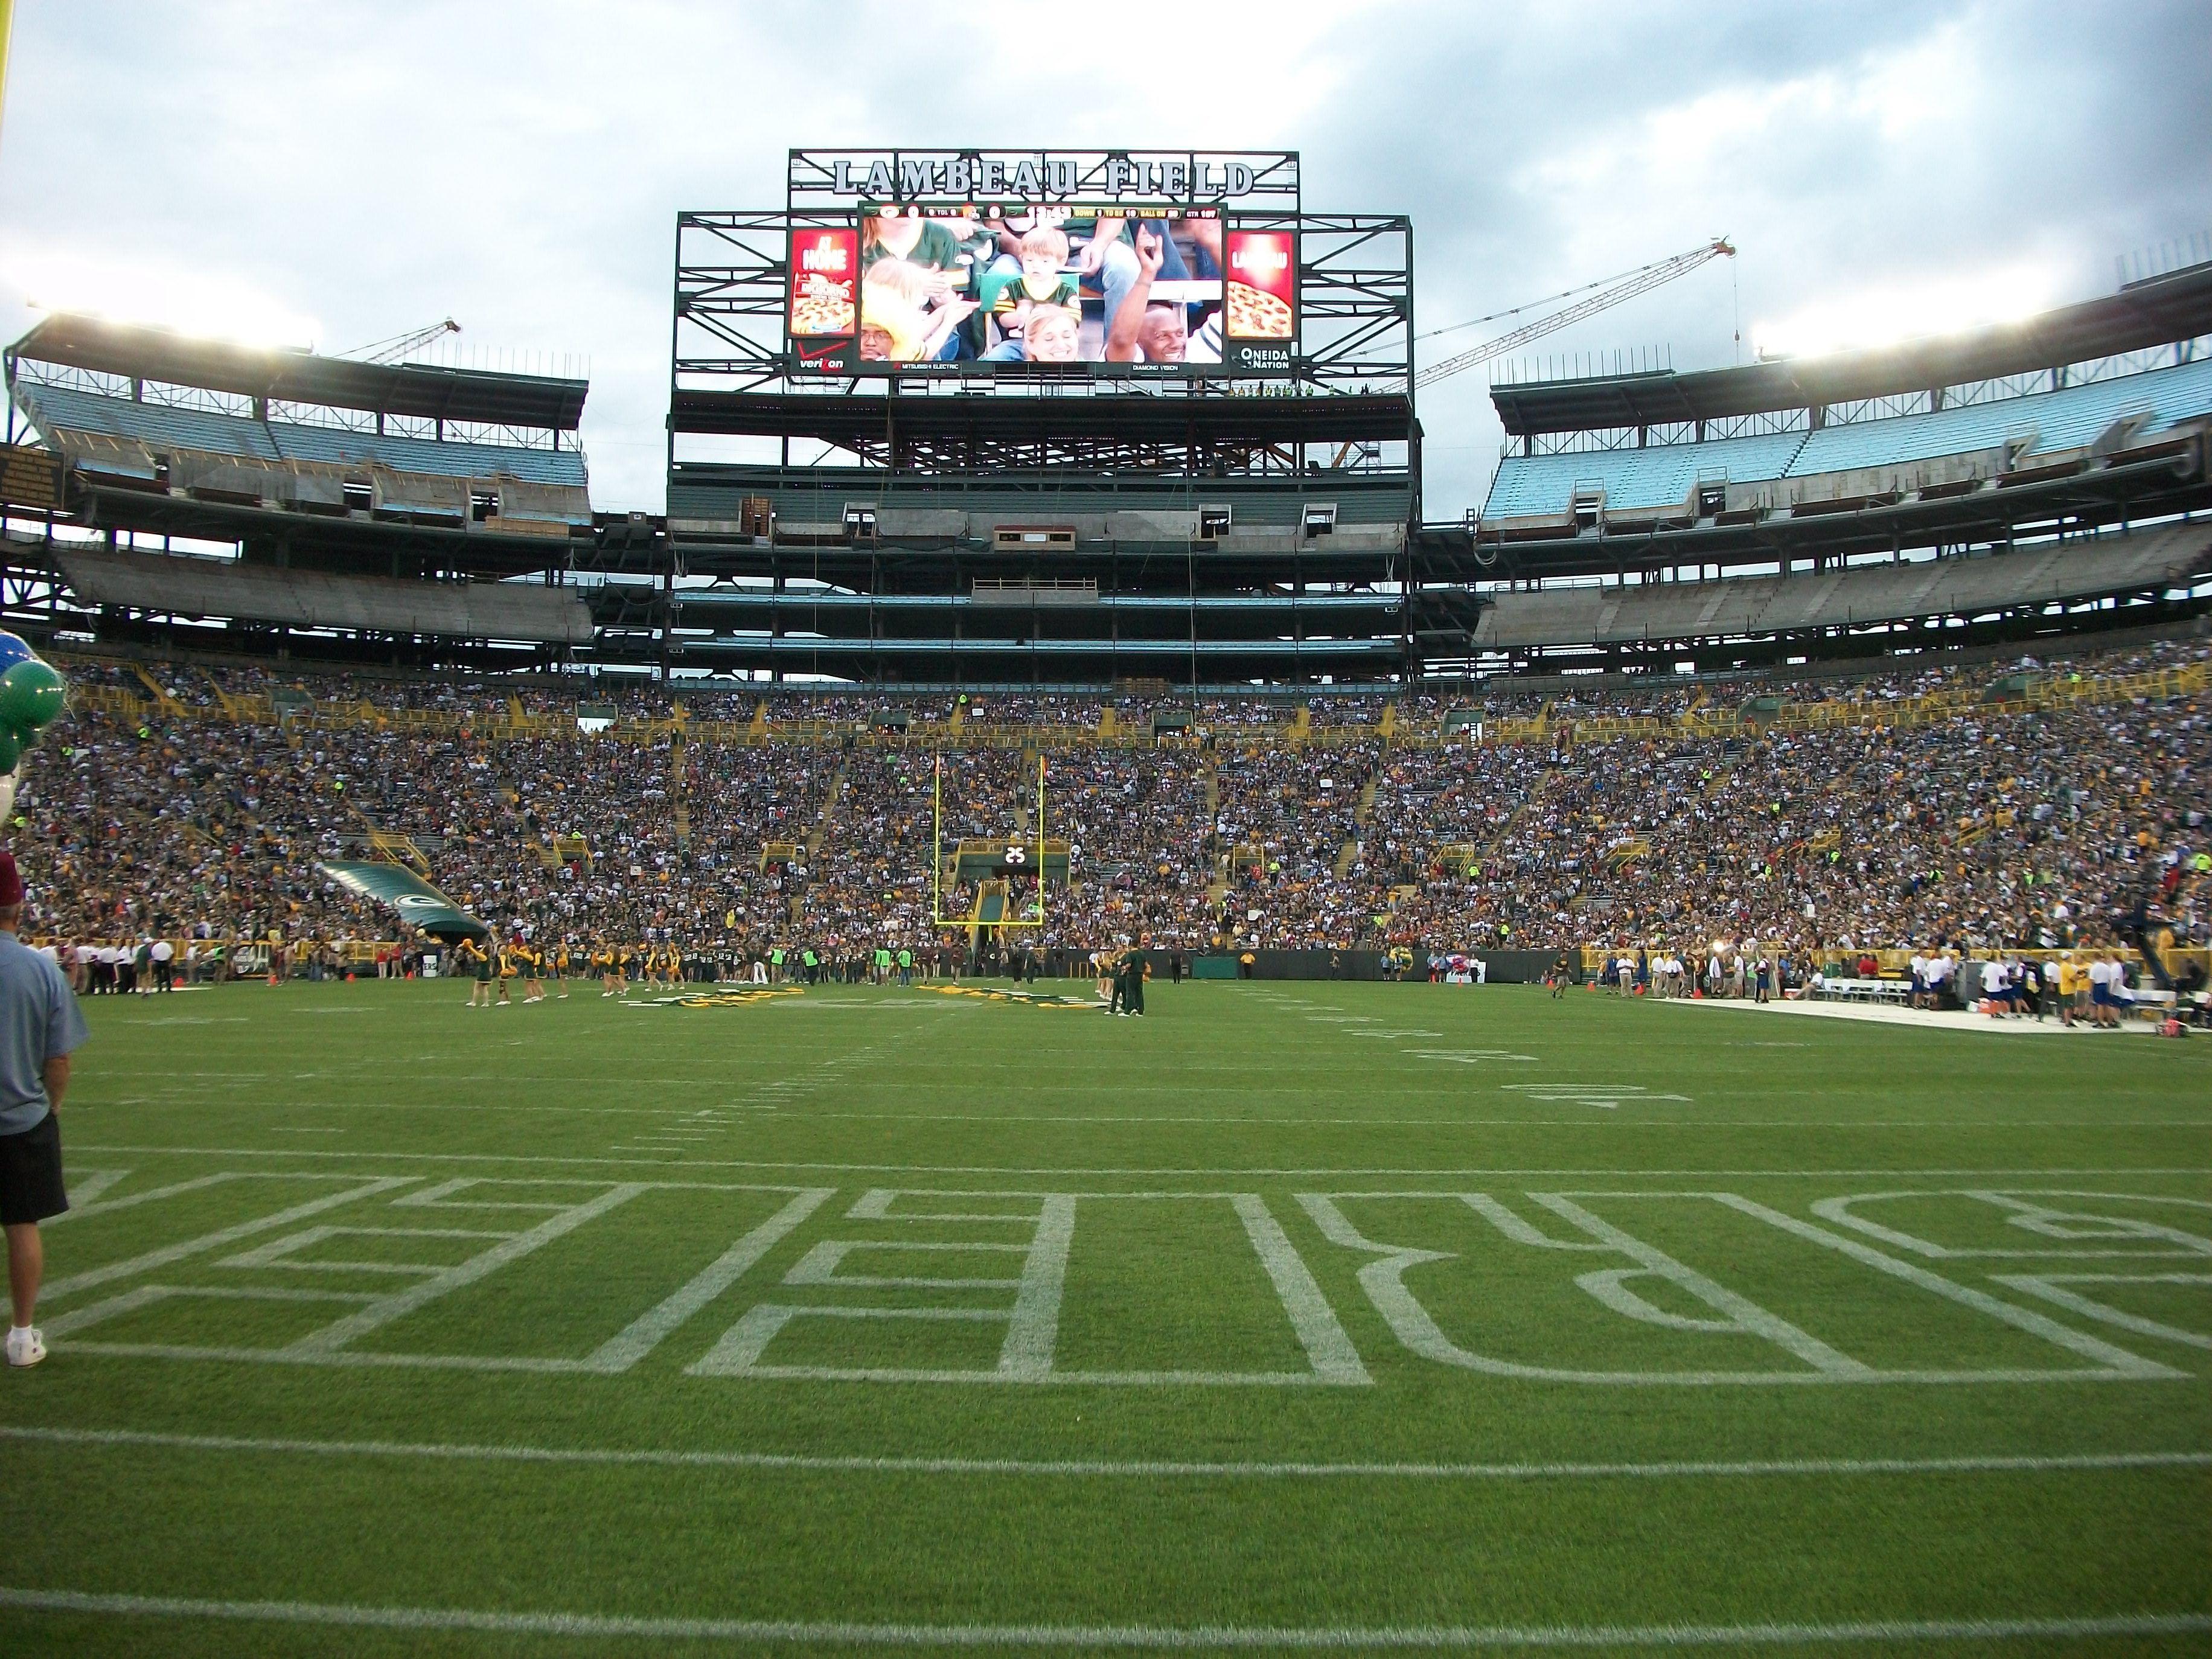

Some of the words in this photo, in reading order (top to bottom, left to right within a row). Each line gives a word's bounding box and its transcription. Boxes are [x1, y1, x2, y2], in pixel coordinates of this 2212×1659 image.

[833, 161, 1078, 195] LAMBEAU
[1104, 161, 1254, 196] FIELD
[803, 249, 847, 270] HOME
[1241, 347, 1289, 360] ONEIDA
[800, 357, 844, 370] verizon
[1253, 360, 1290, 369] NATION
[1005, 846, 1025, 863] 25
